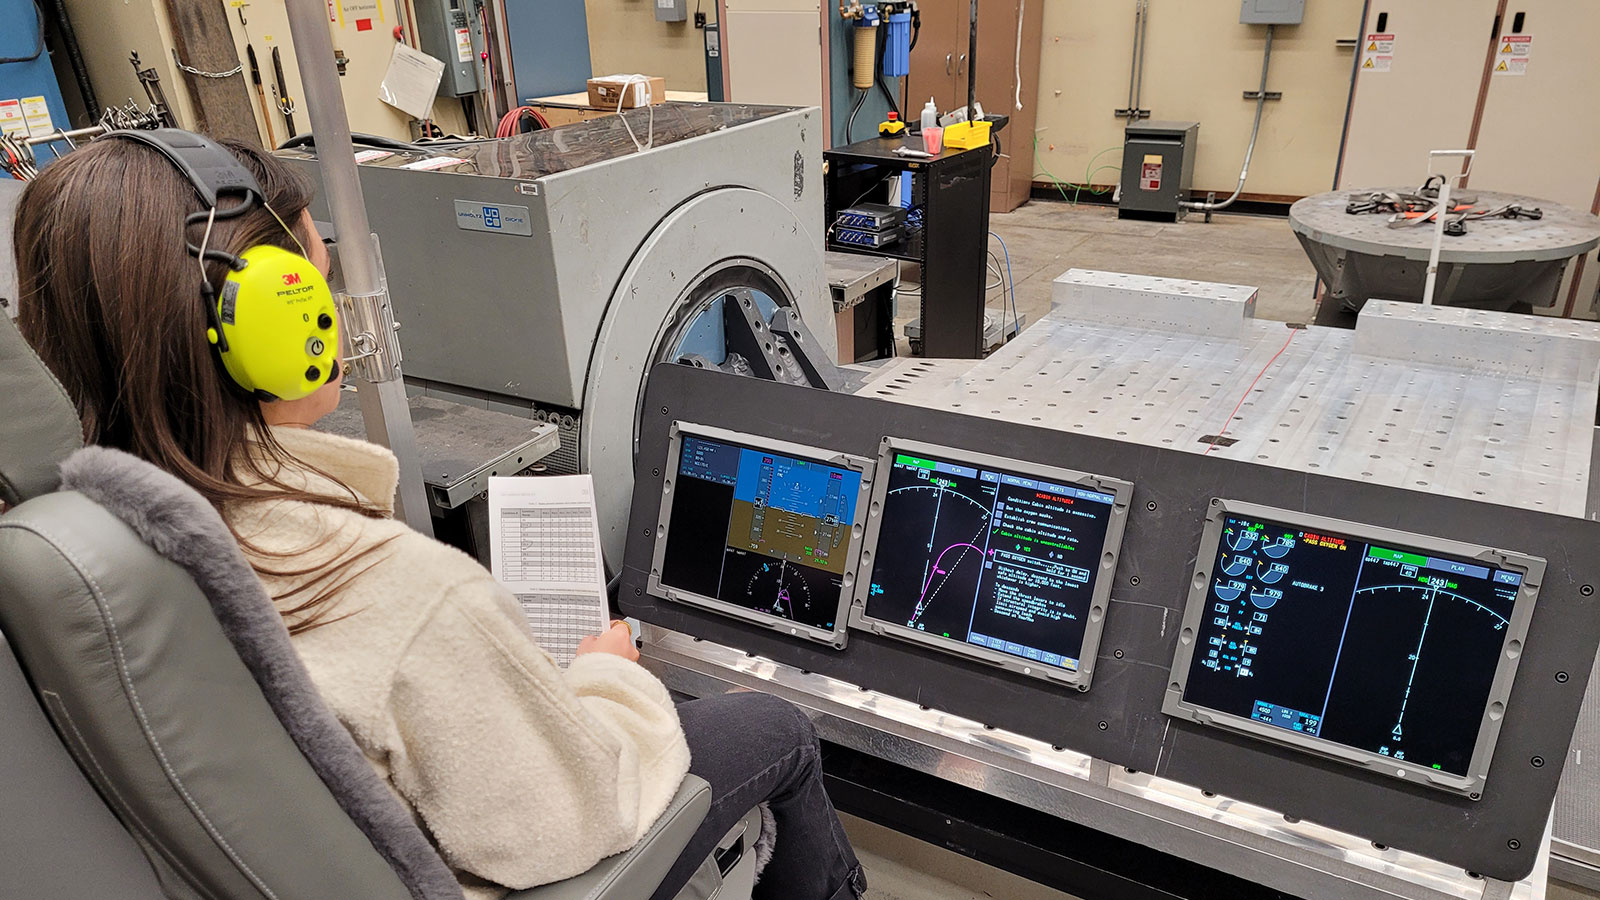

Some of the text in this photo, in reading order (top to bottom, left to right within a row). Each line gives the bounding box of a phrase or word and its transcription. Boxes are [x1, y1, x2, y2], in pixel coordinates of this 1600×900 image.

[281, 272, 302, 286] 3M
[276, 285, 314, 297] PELTOR
[1320, 541, 1338, 549] OXYGEN
[1321, 536, 1345, 545] ALTITUDE
[1292, 580, 1319, 591] AUTOBRAKE
[1431, 578, 1445, 586] 243
[1305, 719, 1318, 728] 199
